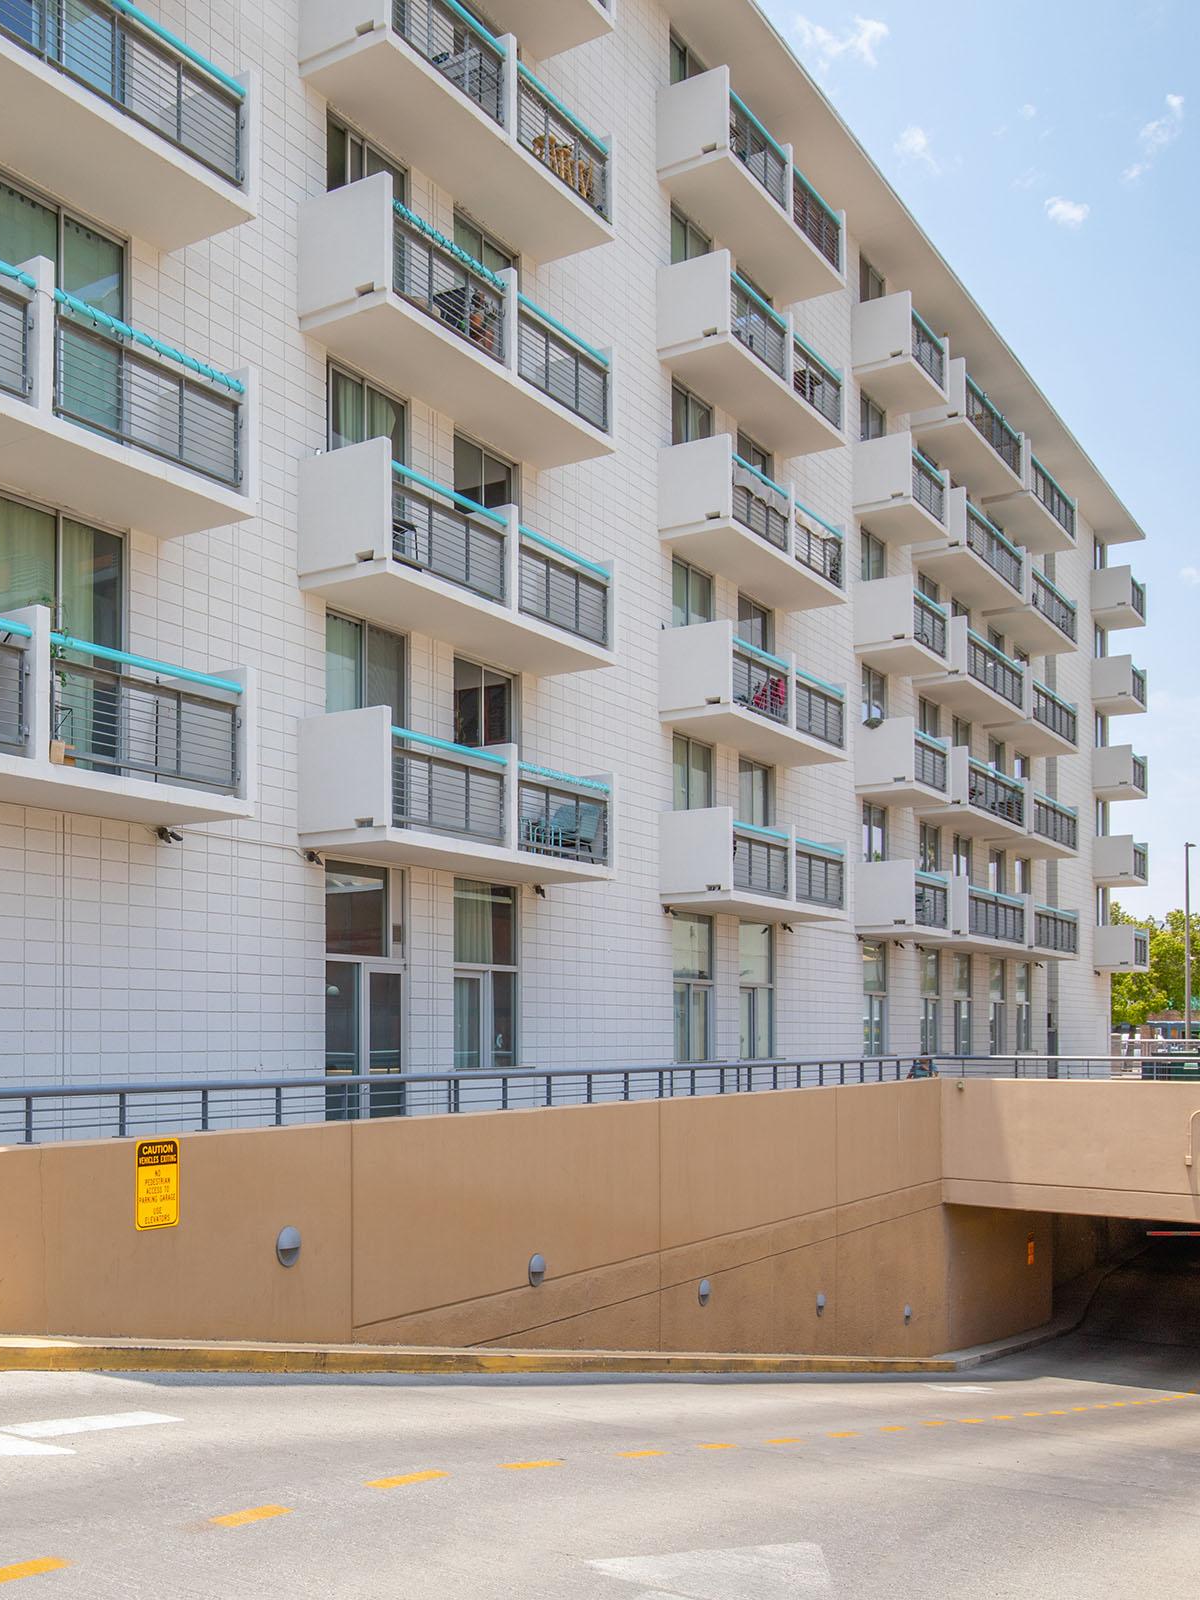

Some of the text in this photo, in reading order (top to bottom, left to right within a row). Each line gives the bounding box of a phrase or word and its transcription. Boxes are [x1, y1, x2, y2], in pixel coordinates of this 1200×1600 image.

[142, 1144, 174, 1156] CAUTION
[139, 1154, 177, 1164] VEHICLES EXITING
